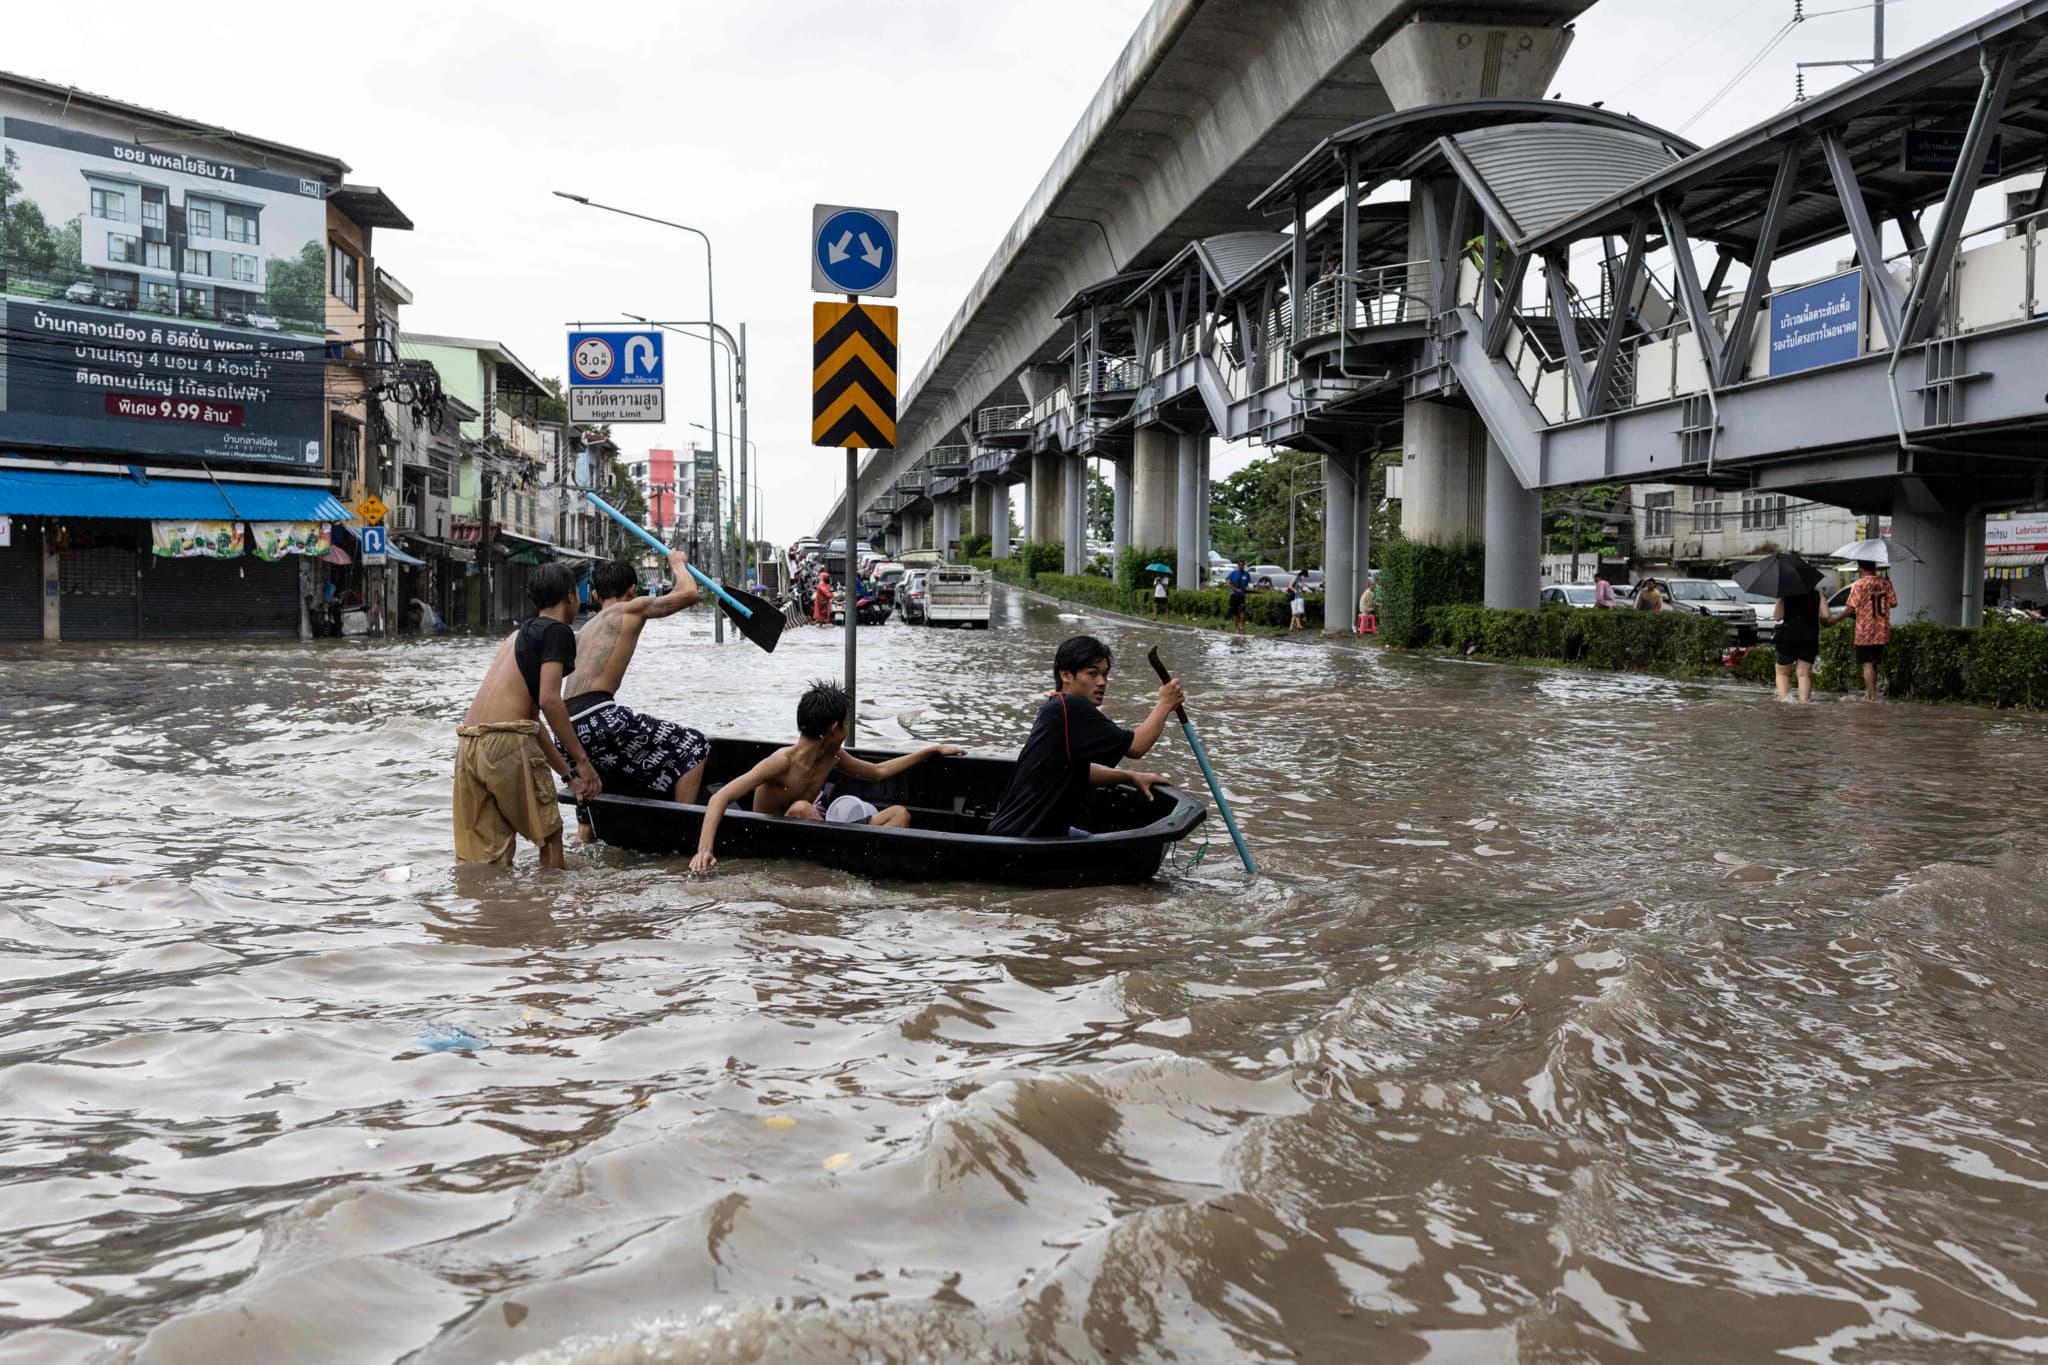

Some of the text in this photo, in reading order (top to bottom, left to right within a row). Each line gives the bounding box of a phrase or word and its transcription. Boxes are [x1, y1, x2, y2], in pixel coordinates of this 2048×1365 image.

[113, 146, 236, 181] ซอย พหลโยธิน 71
[34, 311, 146, 341] บ้านกลางเมือง
[151, 328, 162, 345] ดิ
[166, 328, 209, 350] อิดิชั่น
[75, 340, 143, 368] บ้านใหญ
[148, 352, 159, 366] 4
[165, 354, 198, 370] นอน
[202, 359, 213, 373] 4
[578, 352, 600, 366] 3.0
[76, 368, 173, 396] ติดถนนใหญ่
[119, 399, 156, 417] พิเศษ
[160, 401, 200, 420] 9.99
[576, 390, 658, 411] จำกัดความสูง
[592, 410, 641, 419] Hight Limit
[2015, 525, 2048, 536] Lubricant
[1871, 593, 1888, 618] 10
